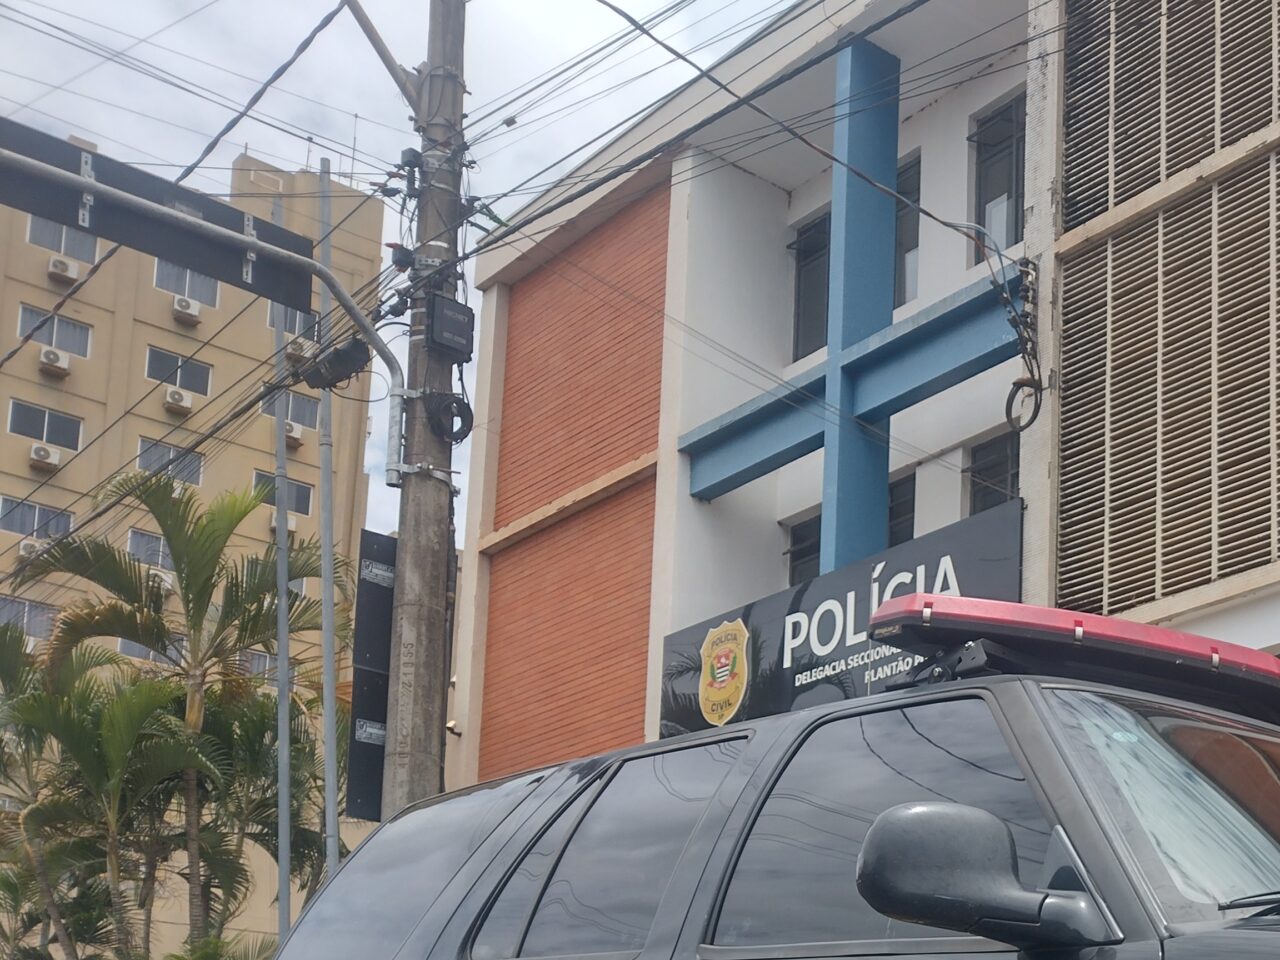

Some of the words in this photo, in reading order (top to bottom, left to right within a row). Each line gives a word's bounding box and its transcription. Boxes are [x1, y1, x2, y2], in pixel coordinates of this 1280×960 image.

[794, 661, 846, 687] DELEGACIA
[847, 645, 903, 669] SECCIONA
[864, 655, 912, 684] PLANTÃO
[710, 699, 732, 713] CIVIL
